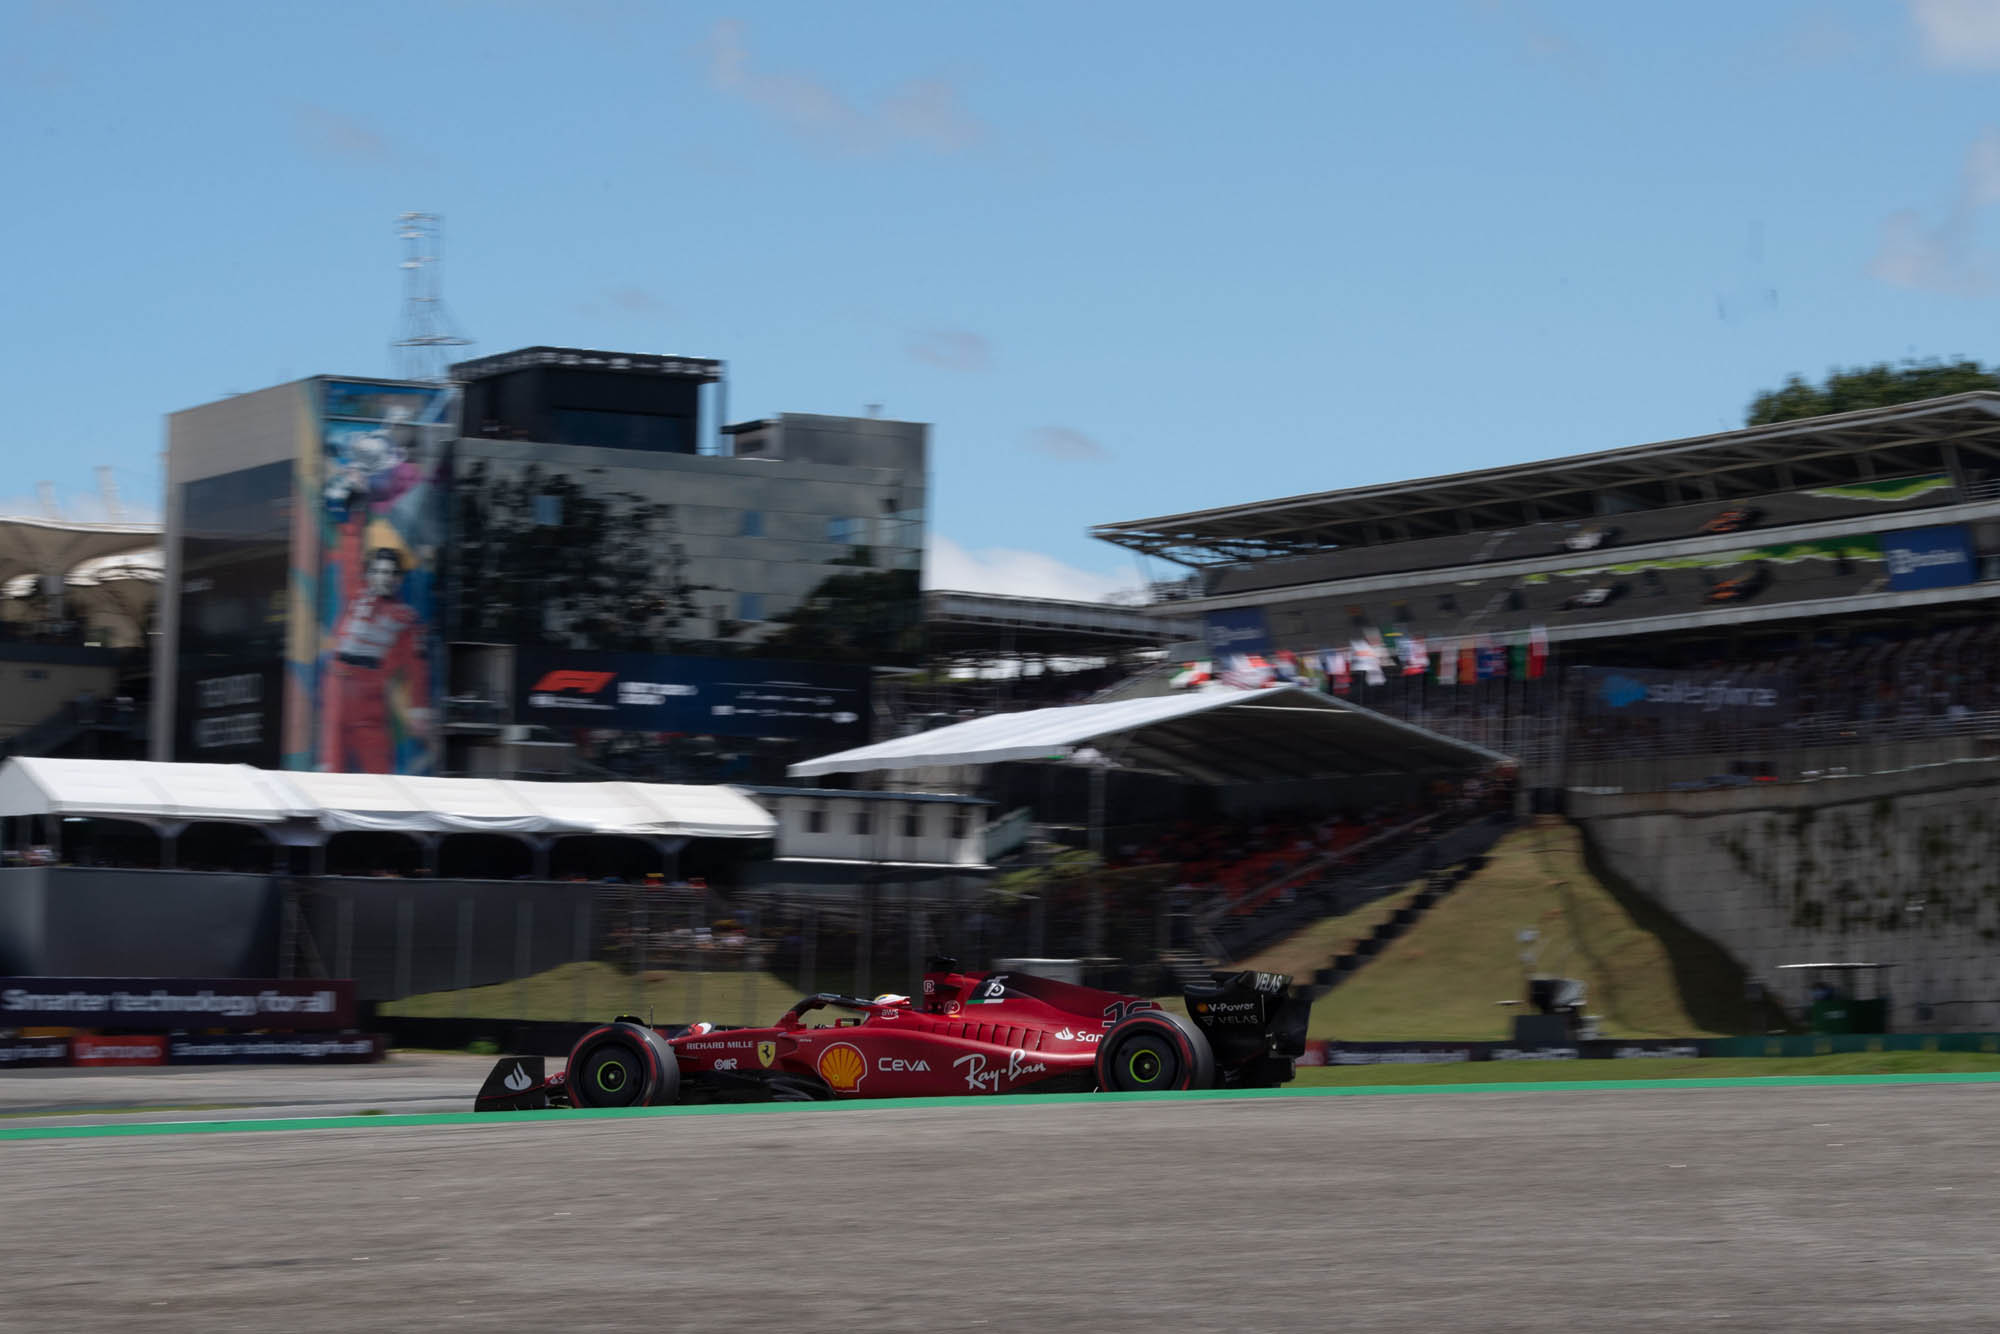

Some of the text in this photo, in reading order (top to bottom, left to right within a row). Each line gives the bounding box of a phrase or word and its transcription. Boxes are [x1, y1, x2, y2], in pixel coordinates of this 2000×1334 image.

[686, 1040, 753, 1050] RICHARD MILLE
[953, 1048, 1047, 1092] Ray-Ban
